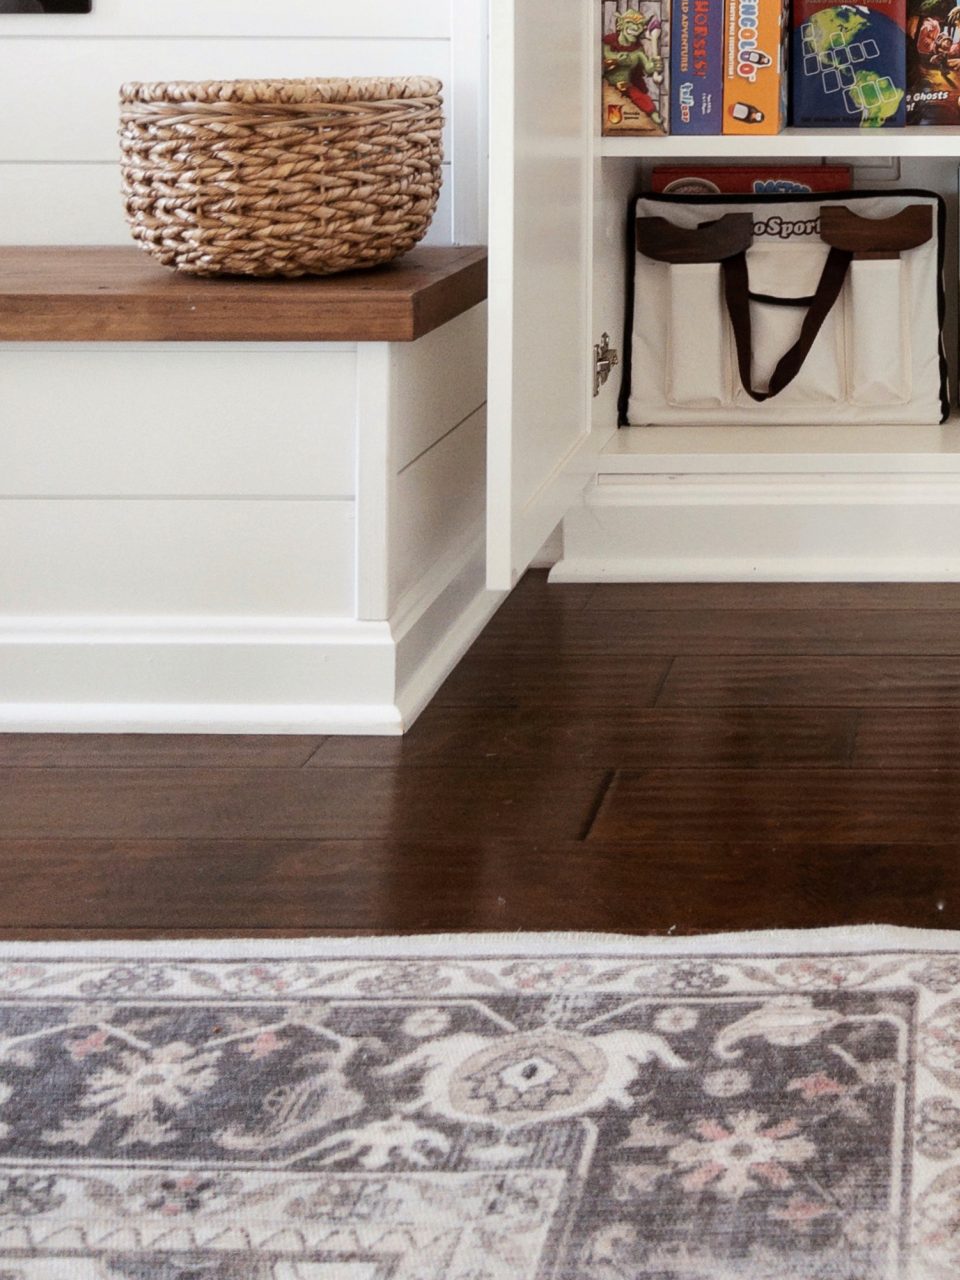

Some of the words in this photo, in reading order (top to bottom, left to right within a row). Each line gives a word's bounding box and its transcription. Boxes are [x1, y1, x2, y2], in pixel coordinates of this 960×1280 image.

[681, 14, 691, 72] ADVENTURES
[693, 0, 712, 78] HORSES!
[914, 91, 949, 101] Ghosts
